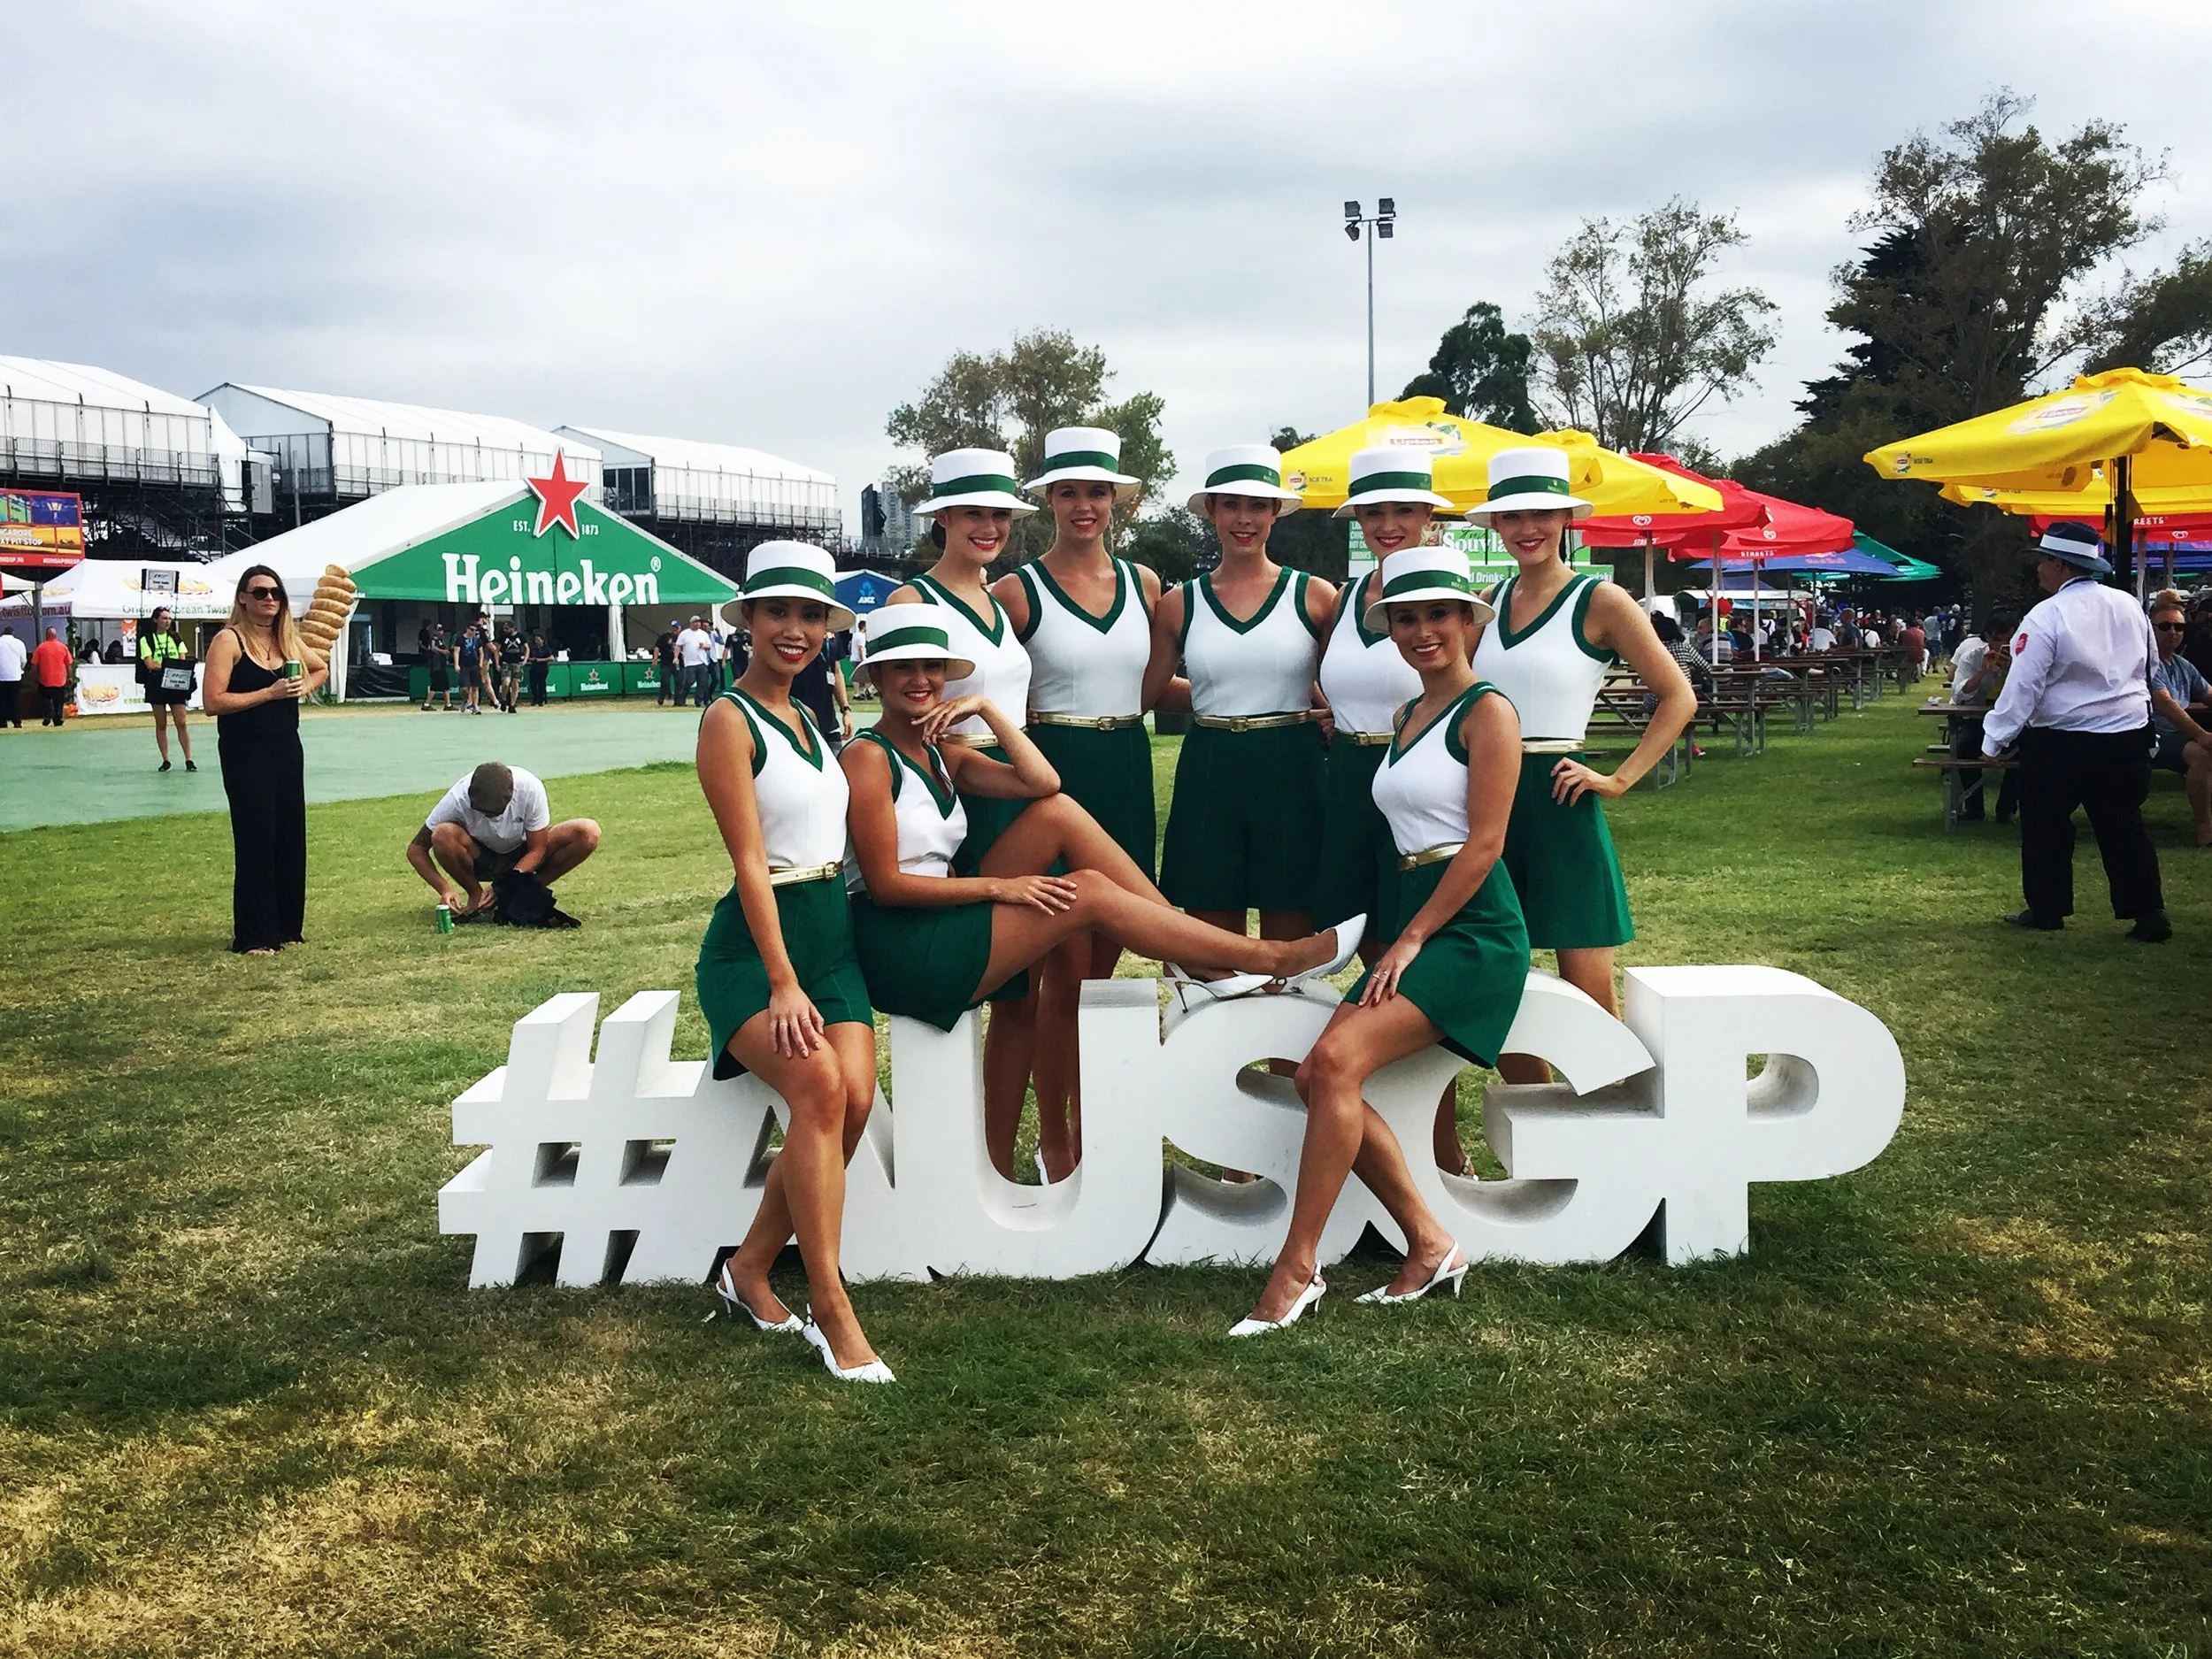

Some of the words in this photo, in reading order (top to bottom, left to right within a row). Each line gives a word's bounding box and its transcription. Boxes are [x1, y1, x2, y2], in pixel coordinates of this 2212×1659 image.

[513, 519, 531, 533] EST.
[581, 524, 599, 535] 1873
[2133, 517, 2164, 526] REETS
[1442, 531, 1508, 553] Souvla
[122, 604, 152, 617] Origin
[637, 680, 662, 689] Heineke
[438, 965, 1905, 1290] #AUSGP
